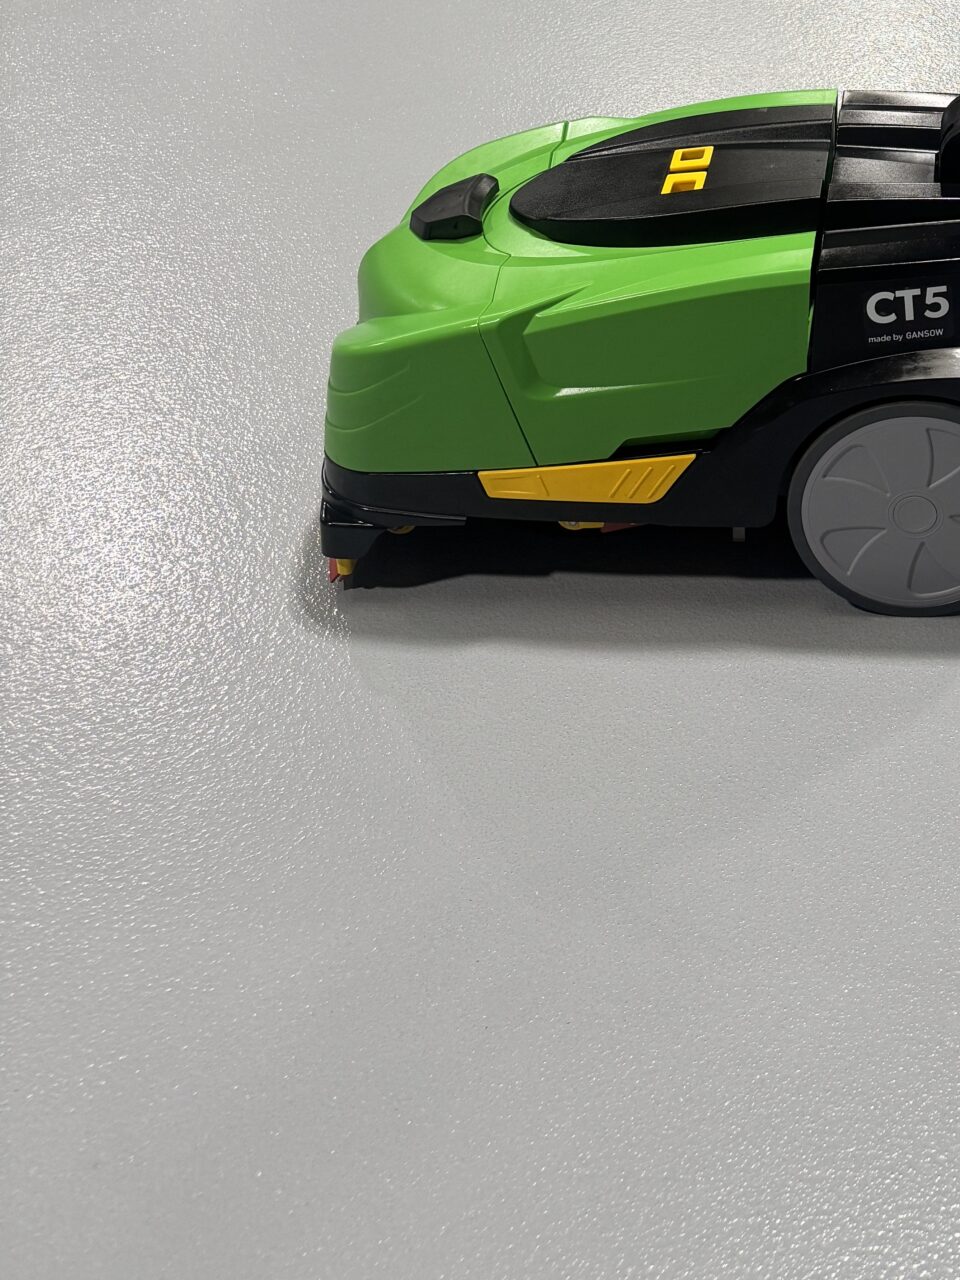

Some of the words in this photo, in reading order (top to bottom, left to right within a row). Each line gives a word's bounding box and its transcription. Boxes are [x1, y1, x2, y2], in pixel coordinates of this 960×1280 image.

[866, 285, 950, 324] CT5
[868, 334, 892, 343] made
[892, 333, 904, 342] by
[905, 328, 944, 340] GANSOW
